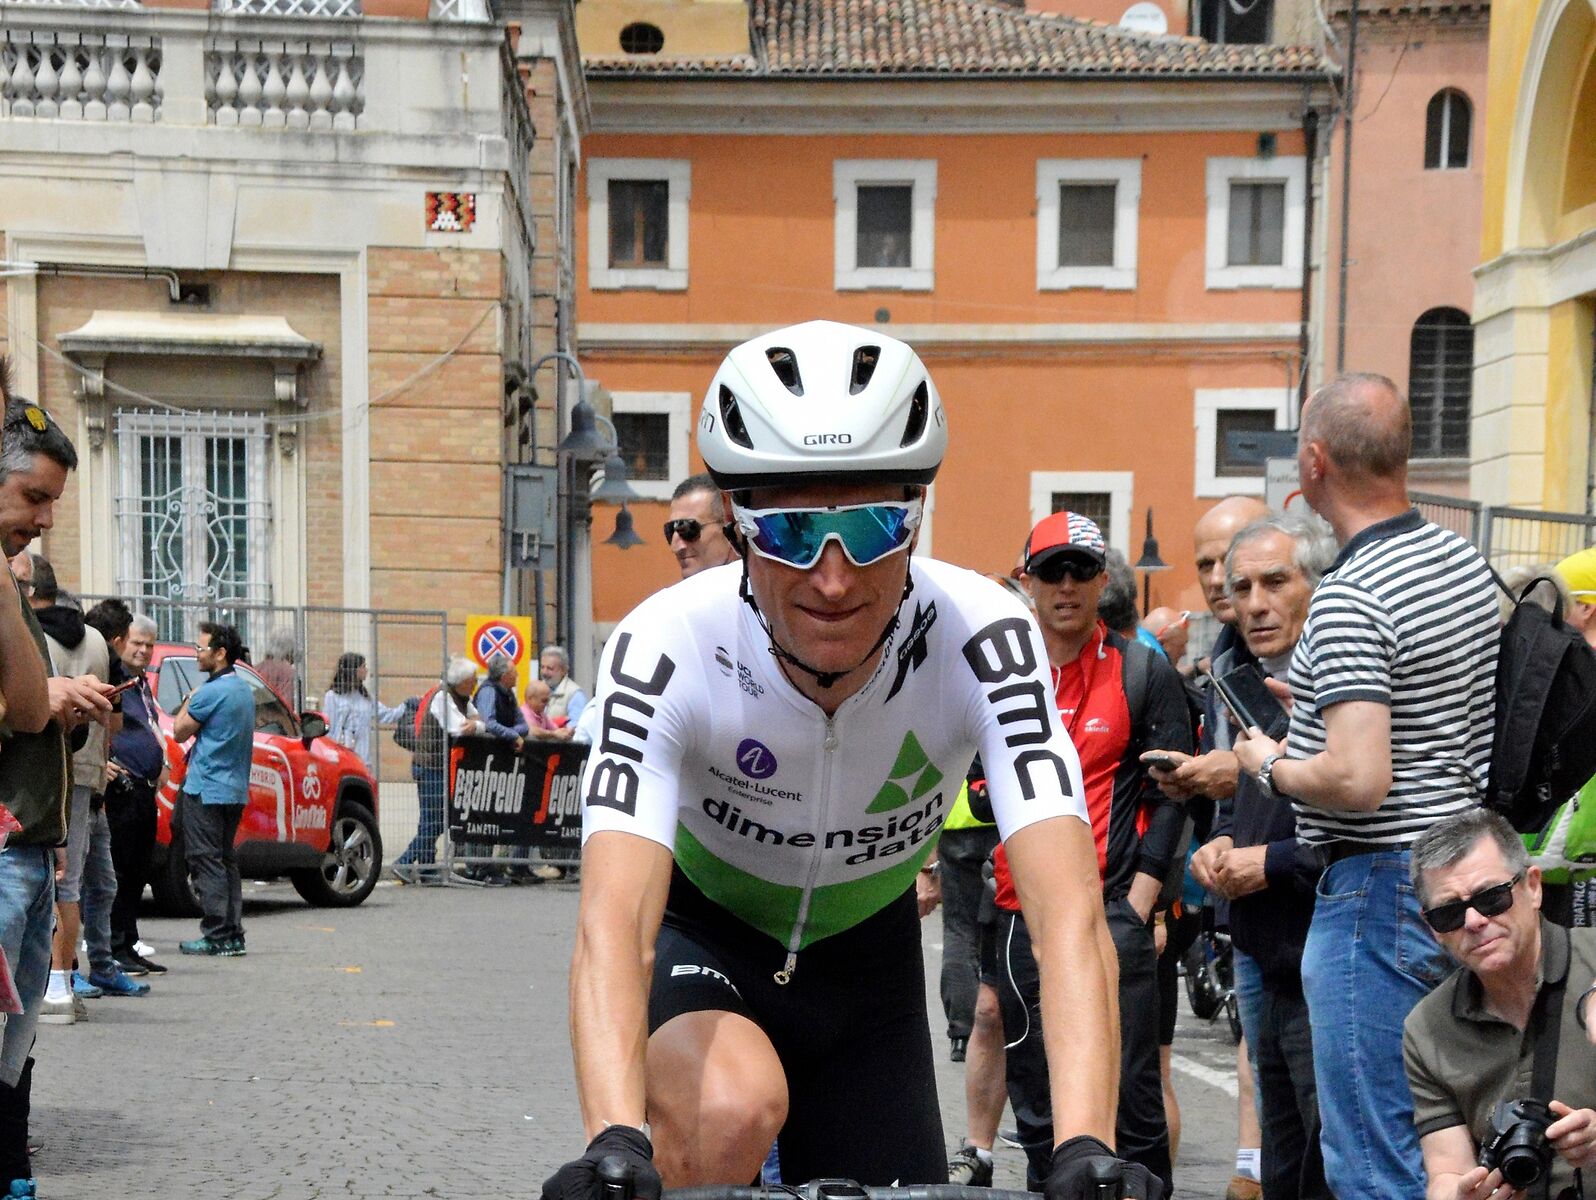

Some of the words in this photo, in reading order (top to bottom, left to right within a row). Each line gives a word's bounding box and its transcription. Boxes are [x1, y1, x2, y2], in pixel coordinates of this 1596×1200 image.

[803, 433, 853, 446] GIRO
[586, 631, 677, 817] BMC
[961, 617, 1074, 801] BMC
[728, 785, 773, 806] Enterprise
[466, 822, 500, 836] ZANETTI
[703, 792, 943, 849] dimension
[845, 813, 944, 866] data
[670, 964, 743, 1000] BM
